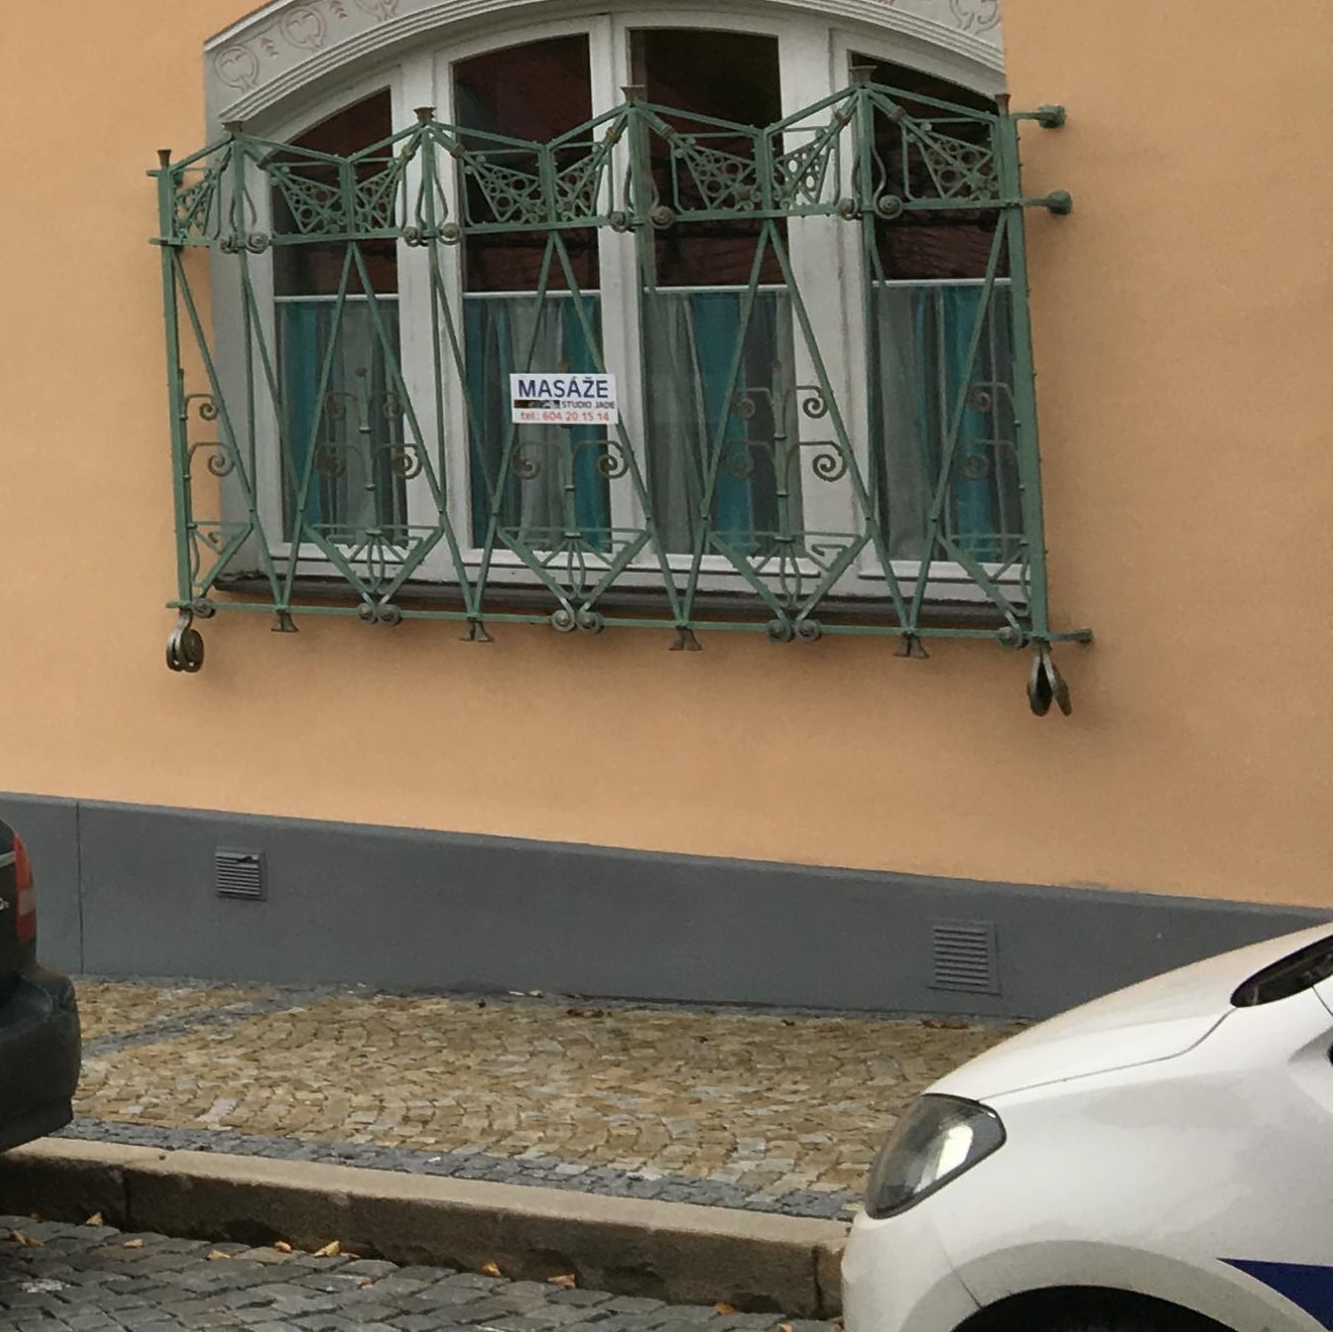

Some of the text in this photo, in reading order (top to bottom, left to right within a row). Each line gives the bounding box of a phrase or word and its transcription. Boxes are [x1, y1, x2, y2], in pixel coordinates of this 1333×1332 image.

[518, 376, 609, 398] MASÁŽE
[561, 400, 593, 409] STUDIO
[566, 411, 579, 421] 20
[582, 411, 594, 422] 15
